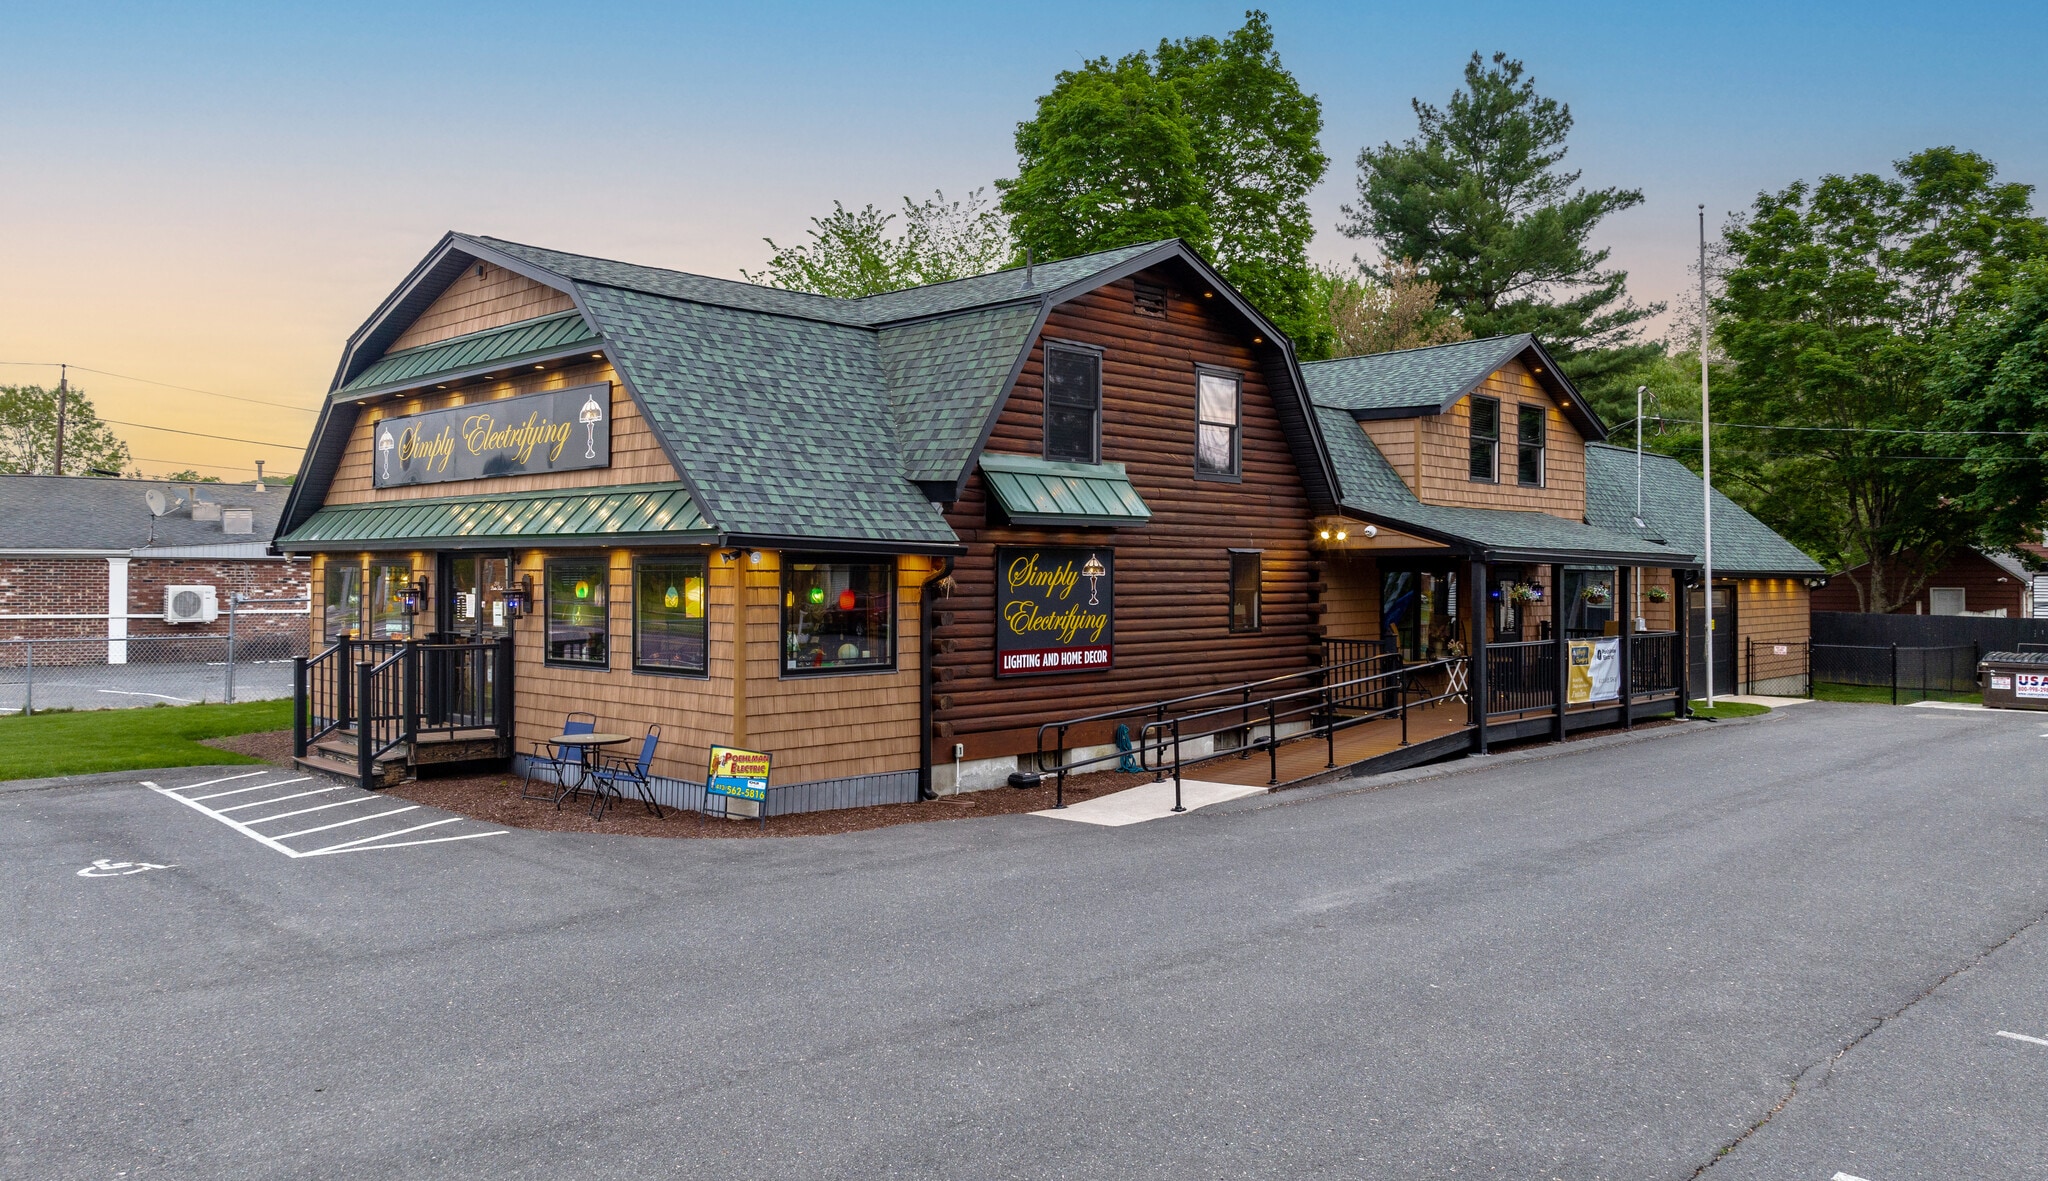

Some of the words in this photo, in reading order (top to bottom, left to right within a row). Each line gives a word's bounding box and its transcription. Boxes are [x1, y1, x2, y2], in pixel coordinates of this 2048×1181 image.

[398, 421, 455, 473] Simply
[462, 411, 572, 465] Electrifying
[1008, 553, 1079, 600] Simply
[1003, 600, 1108, 644] Electrifying
[1004, 654, 1040, 669] LIGHTING
[1042, 652, 1059, 667] AND
[1061, 651, 1082, 666] HOME
[1084, 650, 1107, 664] DECOR
[731, 763, 766, 774] ELECTRIC
[727, 785, 765, 800] 562-5816
